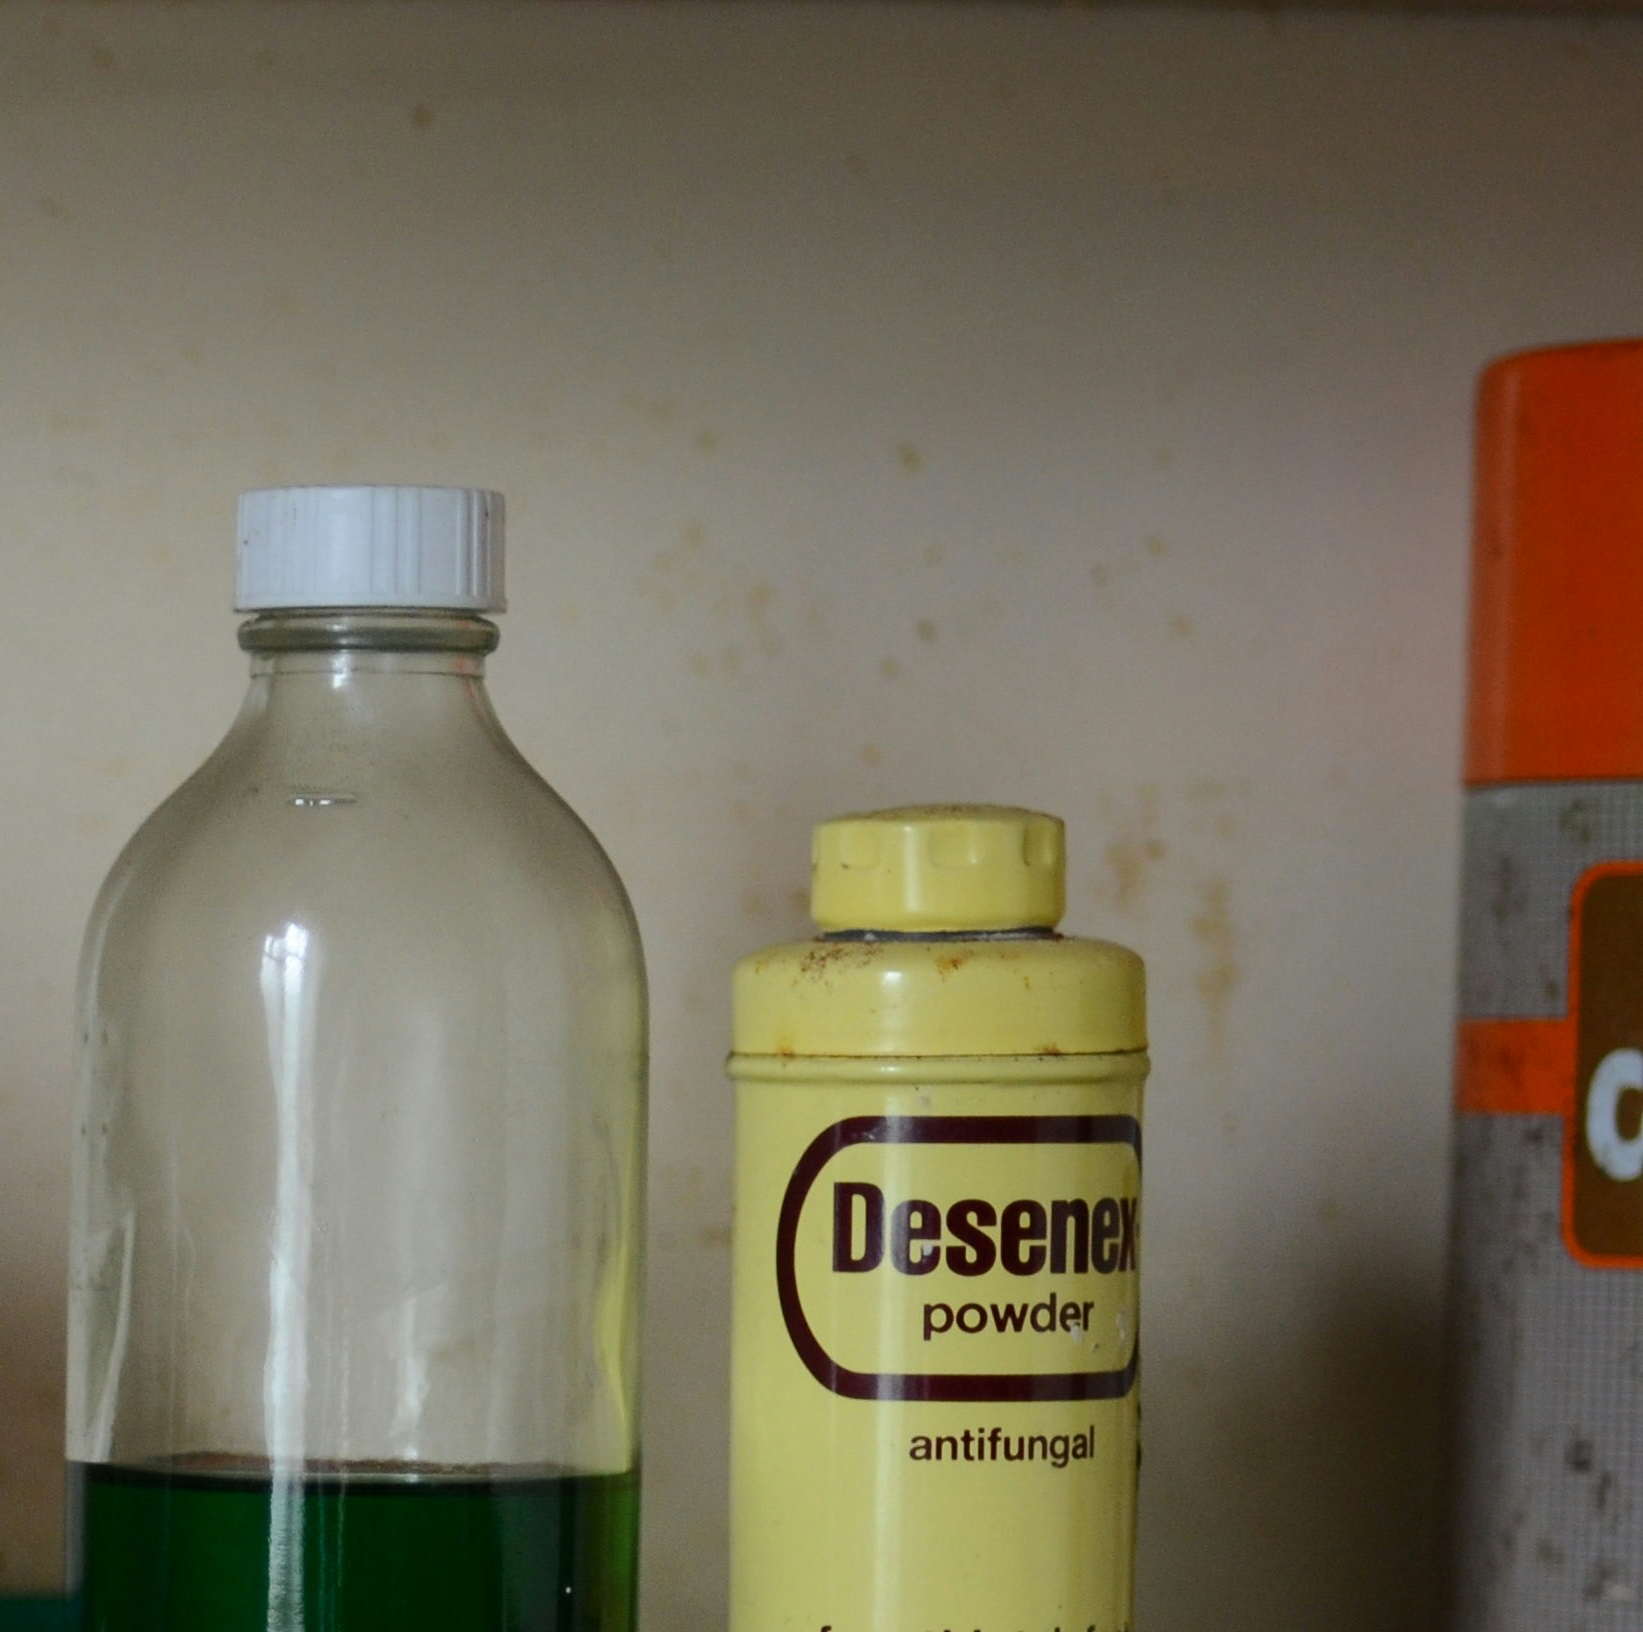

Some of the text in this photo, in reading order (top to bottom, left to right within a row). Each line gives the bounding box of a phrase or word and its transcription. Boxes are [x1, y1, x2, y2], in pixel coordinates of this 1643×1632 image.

[833, 1182, 1137, 1276] Desenex
[923, 1293, 1094, 1341] powder
[909, 1425, 1095, 1468] antifungal
